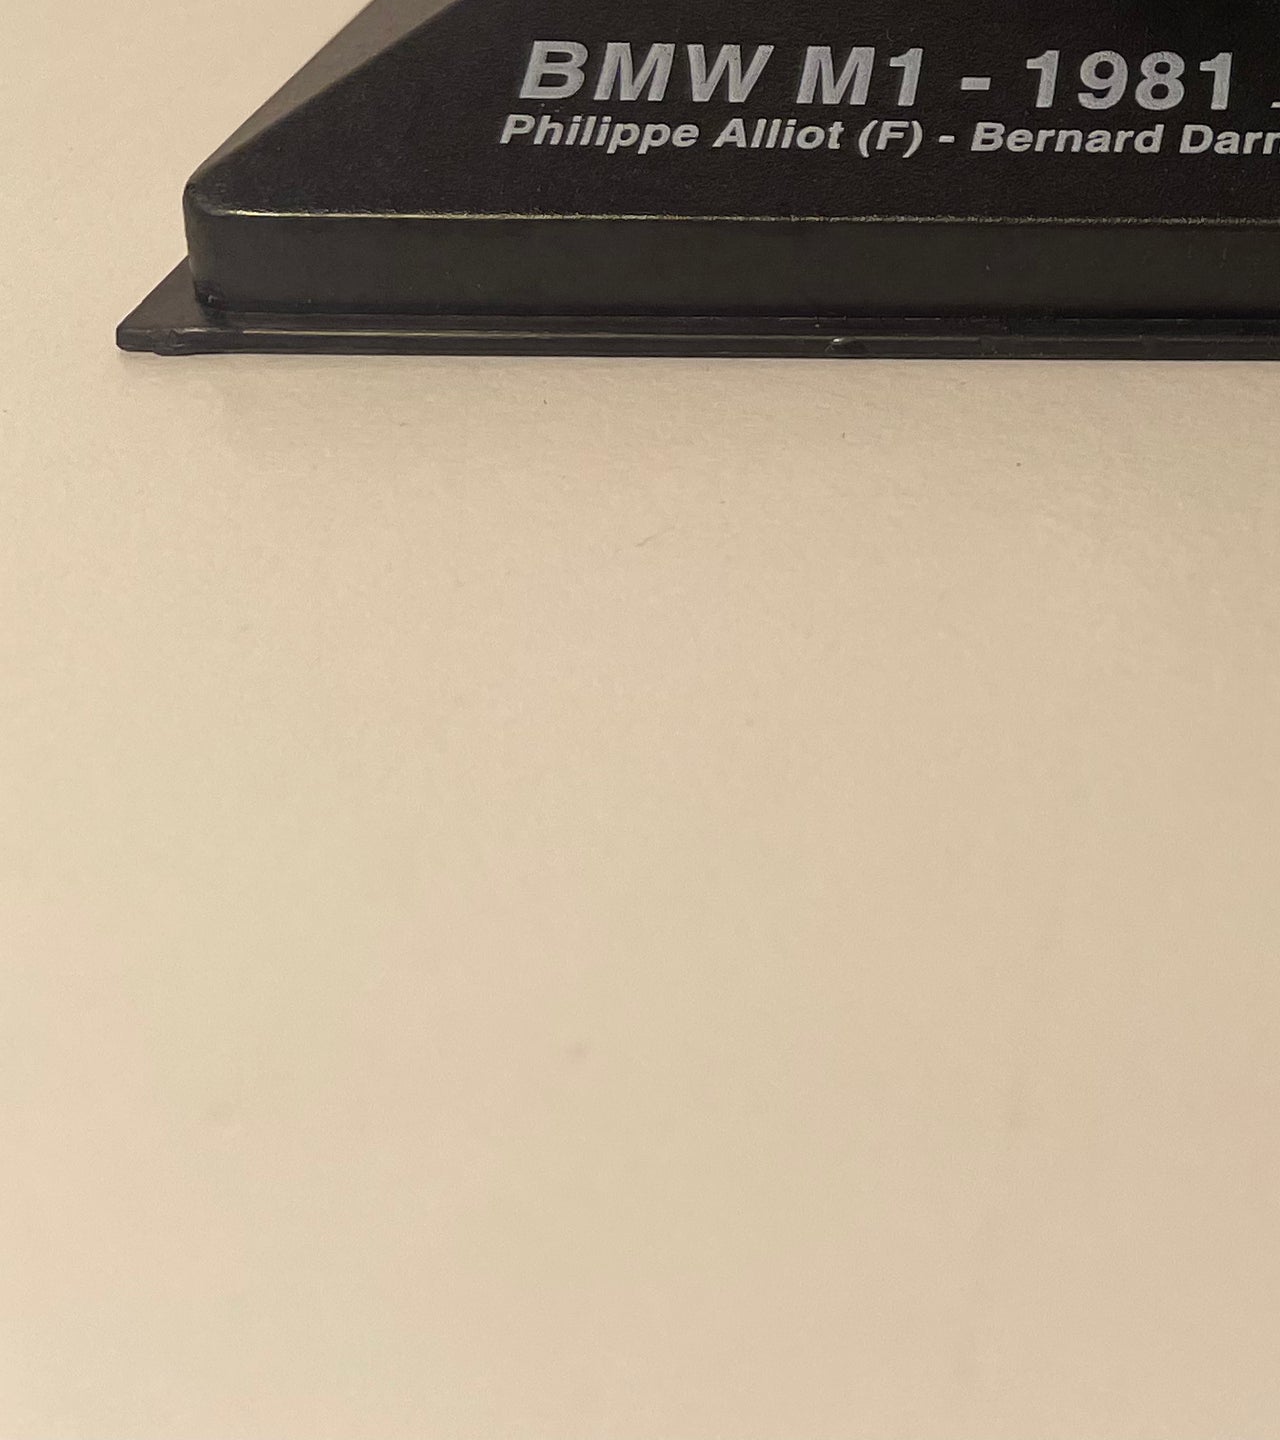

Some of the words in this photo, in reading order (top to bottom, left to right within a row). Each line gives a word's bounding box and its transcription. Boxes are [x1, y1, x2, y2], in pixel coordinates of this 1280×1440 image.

[519, 41, 774, 102] BMW
[796, 46, 923, 106] M1
[961, 77, 990, 90] -
[1027, 50, 1232, 110] 1981
[500, 113, 699, 154] Philippe
[712, 118, 845, 149] Alliot
[859, 120, 922, 158] (F)
[938, 135, 955, 144] -
[971, 121, 1165, 154] Bernard
